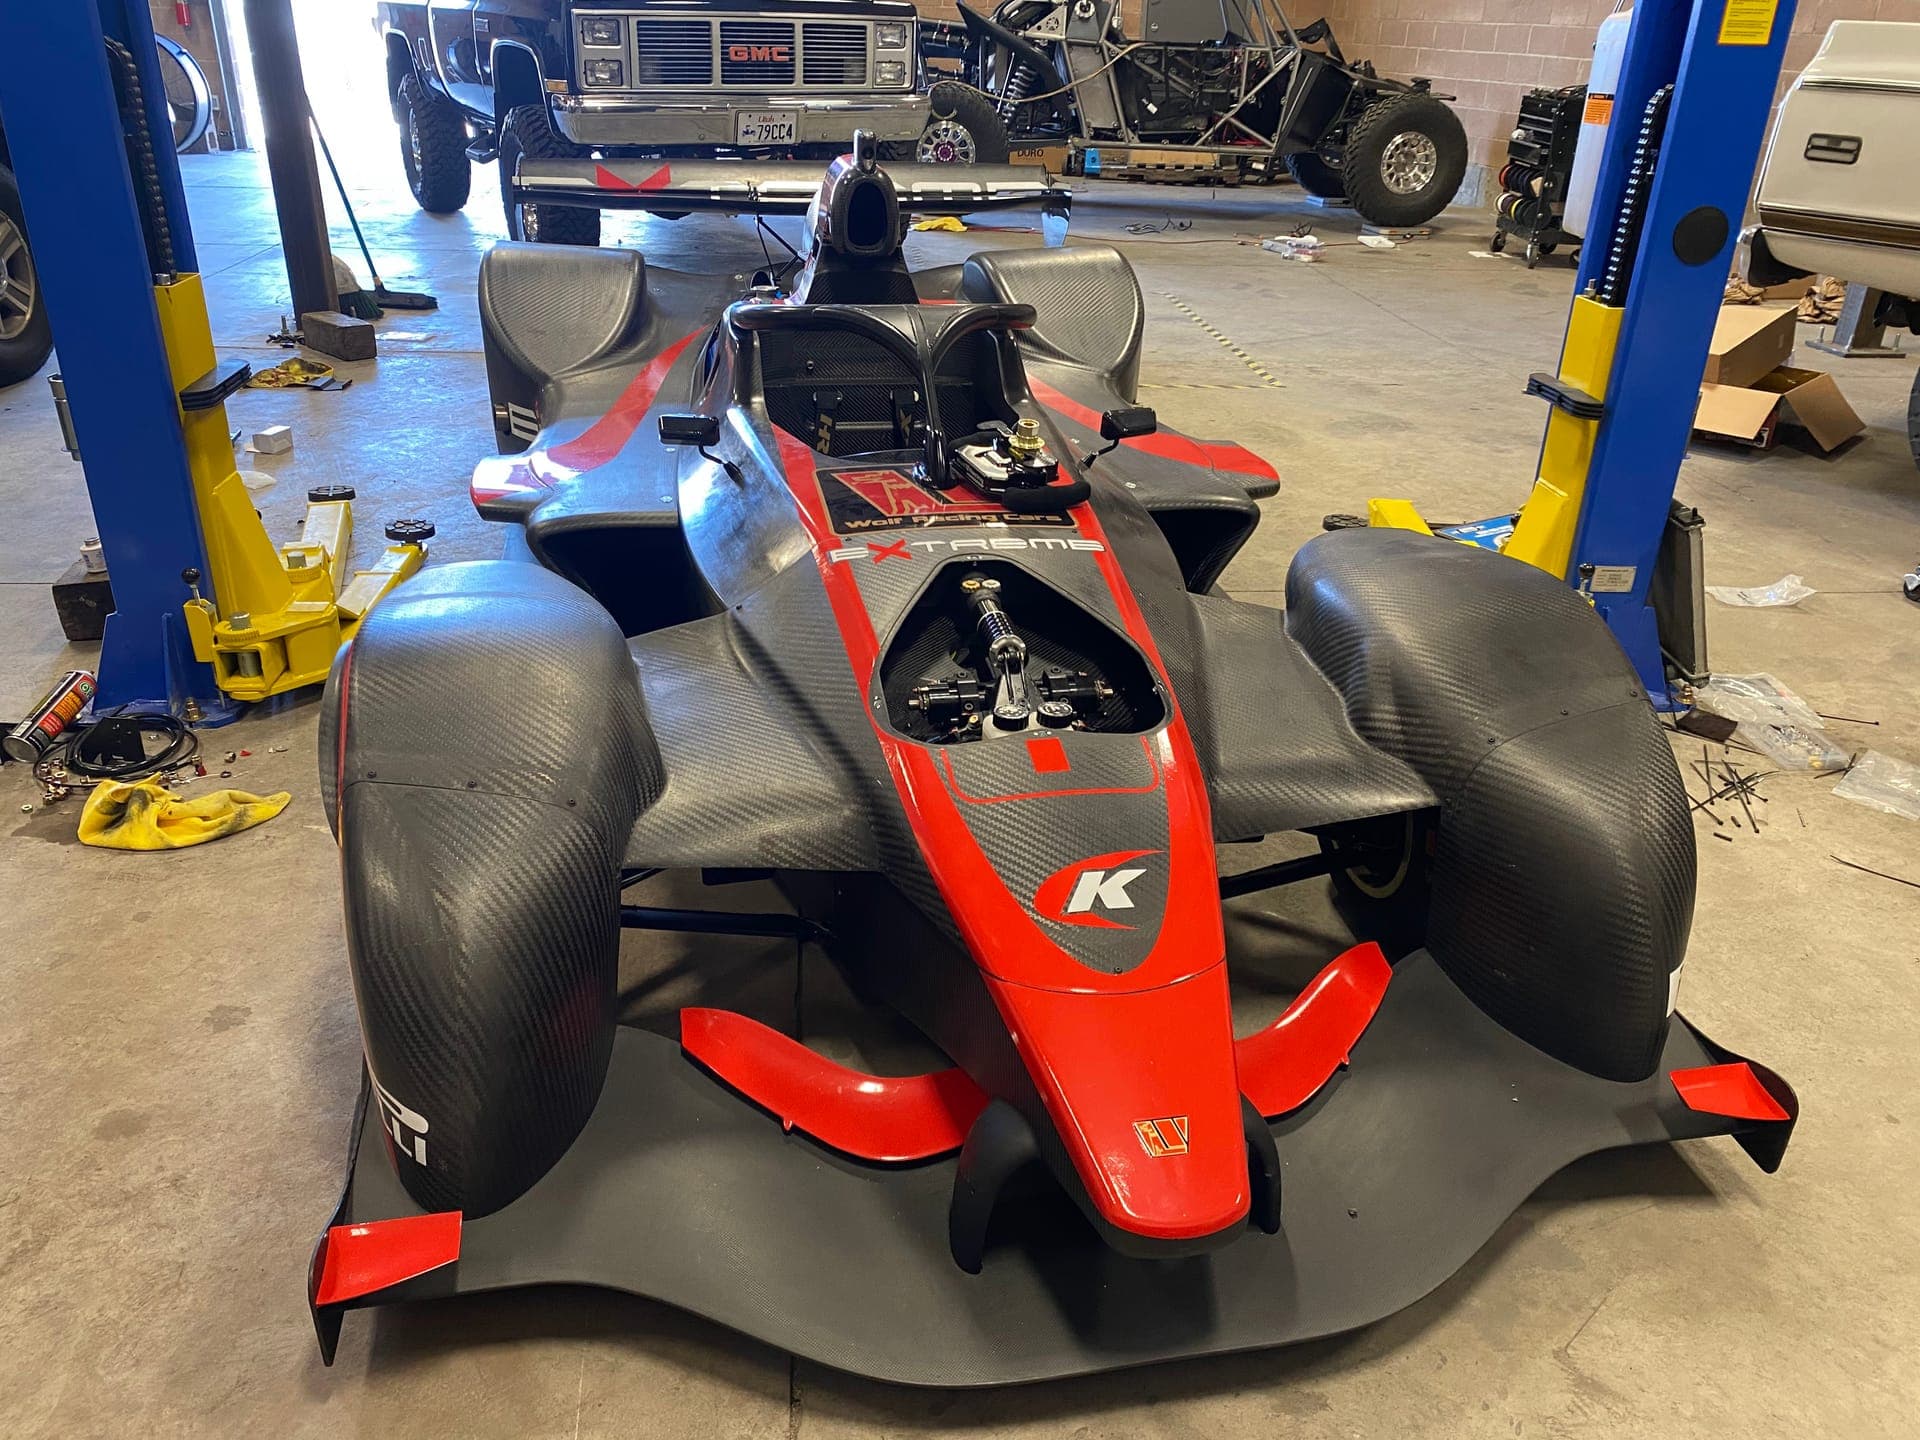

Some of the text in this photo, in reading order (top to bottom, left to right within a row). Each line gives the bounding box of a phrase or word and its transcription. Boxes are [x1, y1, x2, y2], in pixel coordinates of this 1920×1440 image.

[729, 46, 789, 62] GMC
[758, 123, 793, 140] 79CC4
[1017, 149, 1044, 157] DURO
[1067, 868, 1147, 912] K
